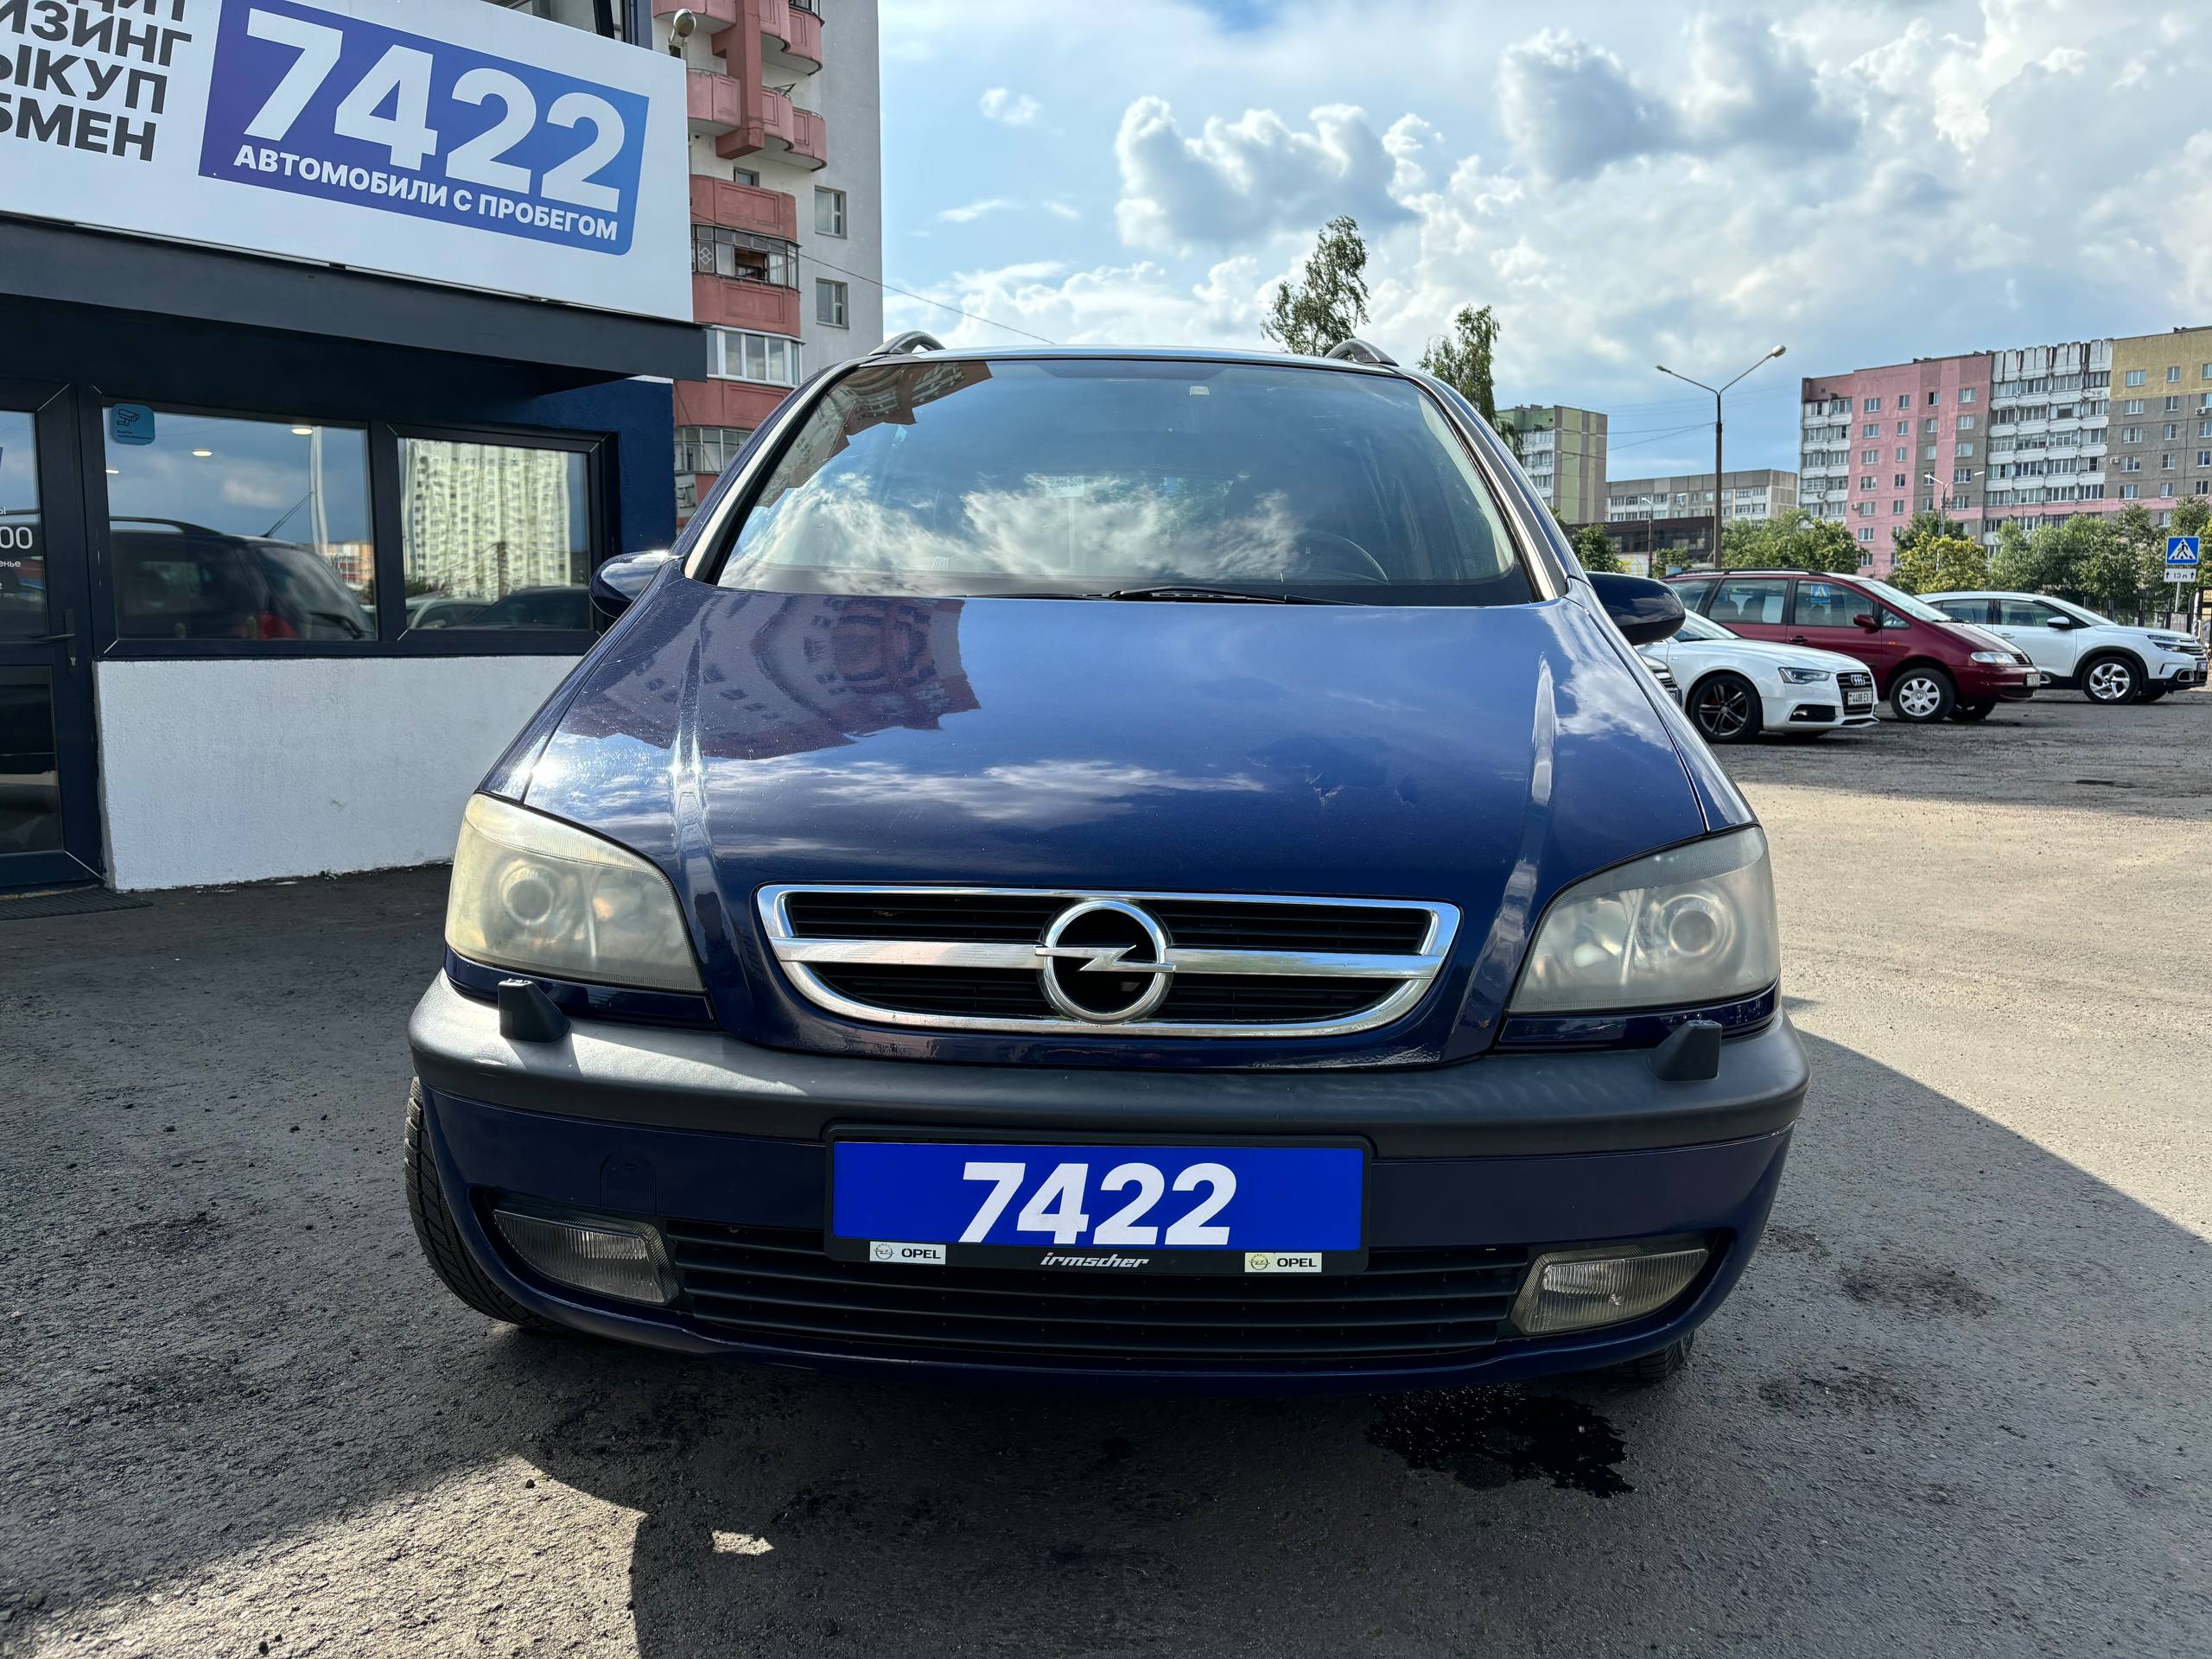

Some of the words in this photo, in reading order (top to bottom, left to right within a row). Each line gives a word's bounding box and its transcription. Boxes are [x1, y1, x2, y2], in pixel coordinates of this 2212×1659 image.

[244, 8, 625, 213] 7422
[233, 144, 447, 207] АВТОМОБИЛИ
[453, 189, 473, 213] С
[479, 194, 618, 242] ПРОБЕГОМ
[958, 1162, 1236, 1245] 7422
[901, 1248, 941, 1259] OPEL
[1040, 1252, 1149, 1268] irmscher
[1277, 1258, 1317, 1268] OPEL
